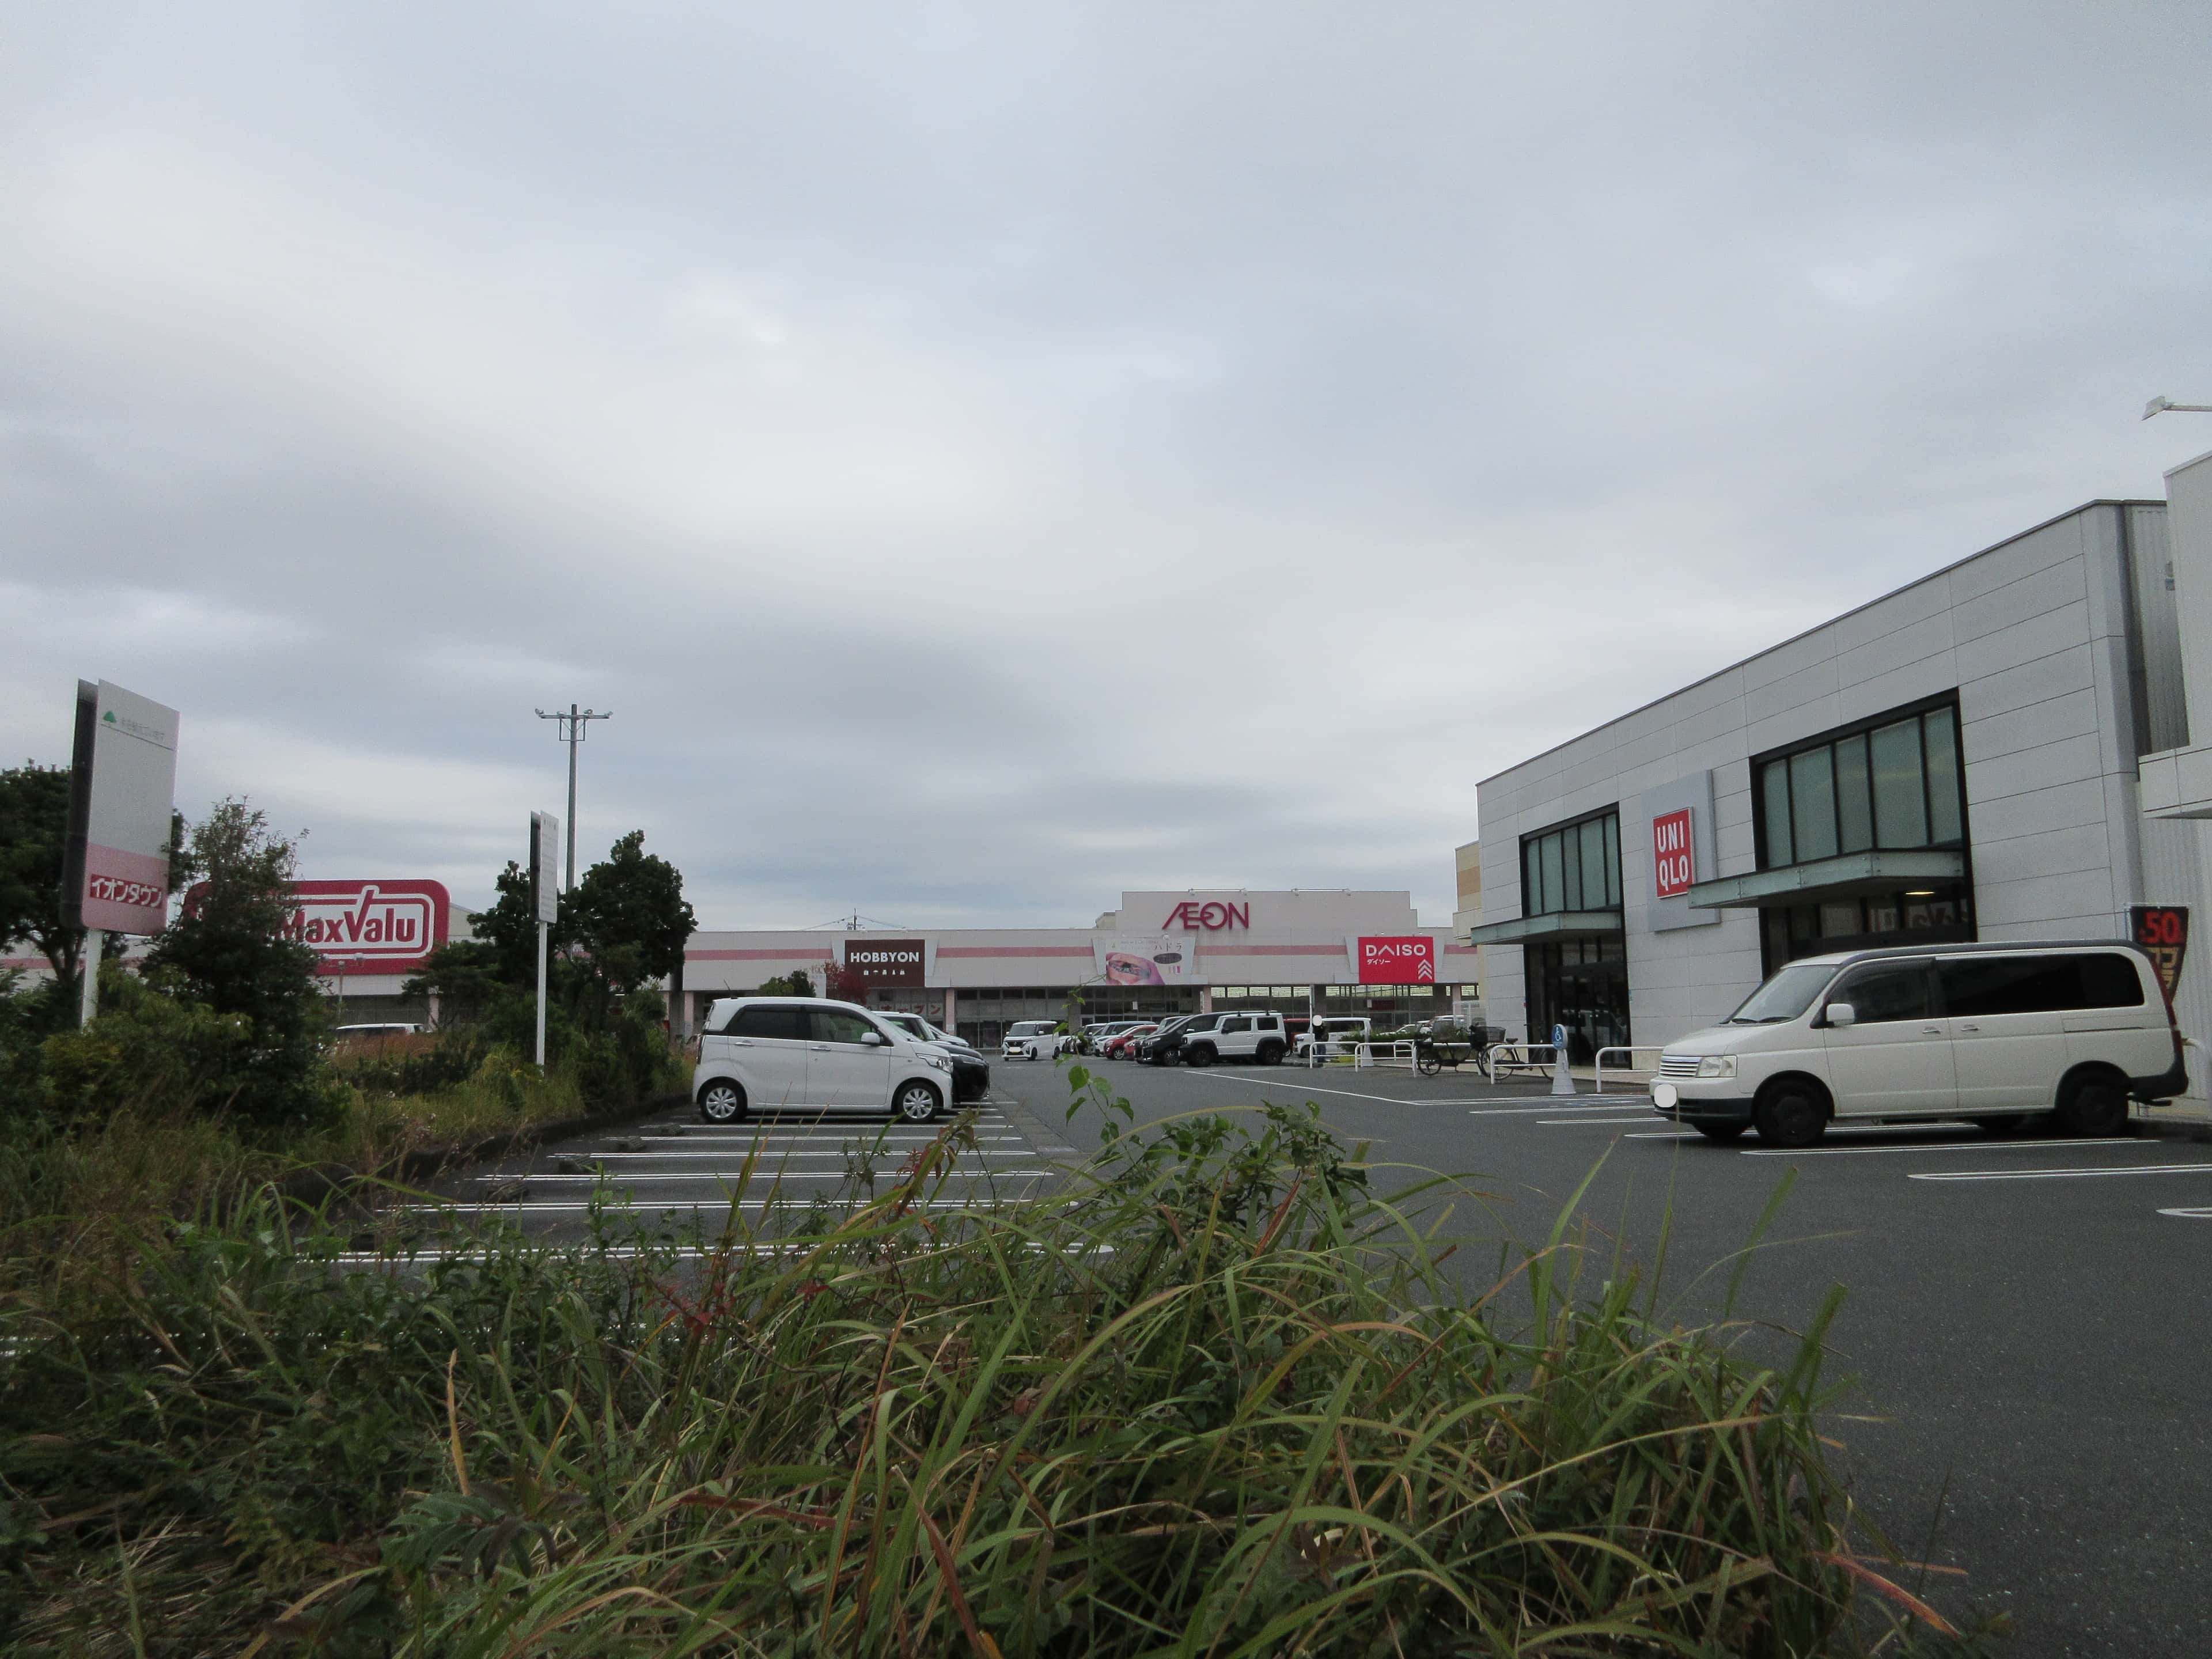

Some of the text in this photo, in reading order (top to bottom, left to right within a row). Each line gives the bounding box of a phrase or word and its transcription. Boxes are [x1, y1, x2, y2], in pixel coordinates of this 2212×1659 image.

[1657, 820, 1684, 853] UNI
[1659, 855, 1689, 891] QLO
[92, 877, 162, 907] イオンタウン
[277, 889, 415, 943] MaxValu
[850, 952, 919, 963] HOBBYON
[1366, 944, 1426, 956] DAISO
